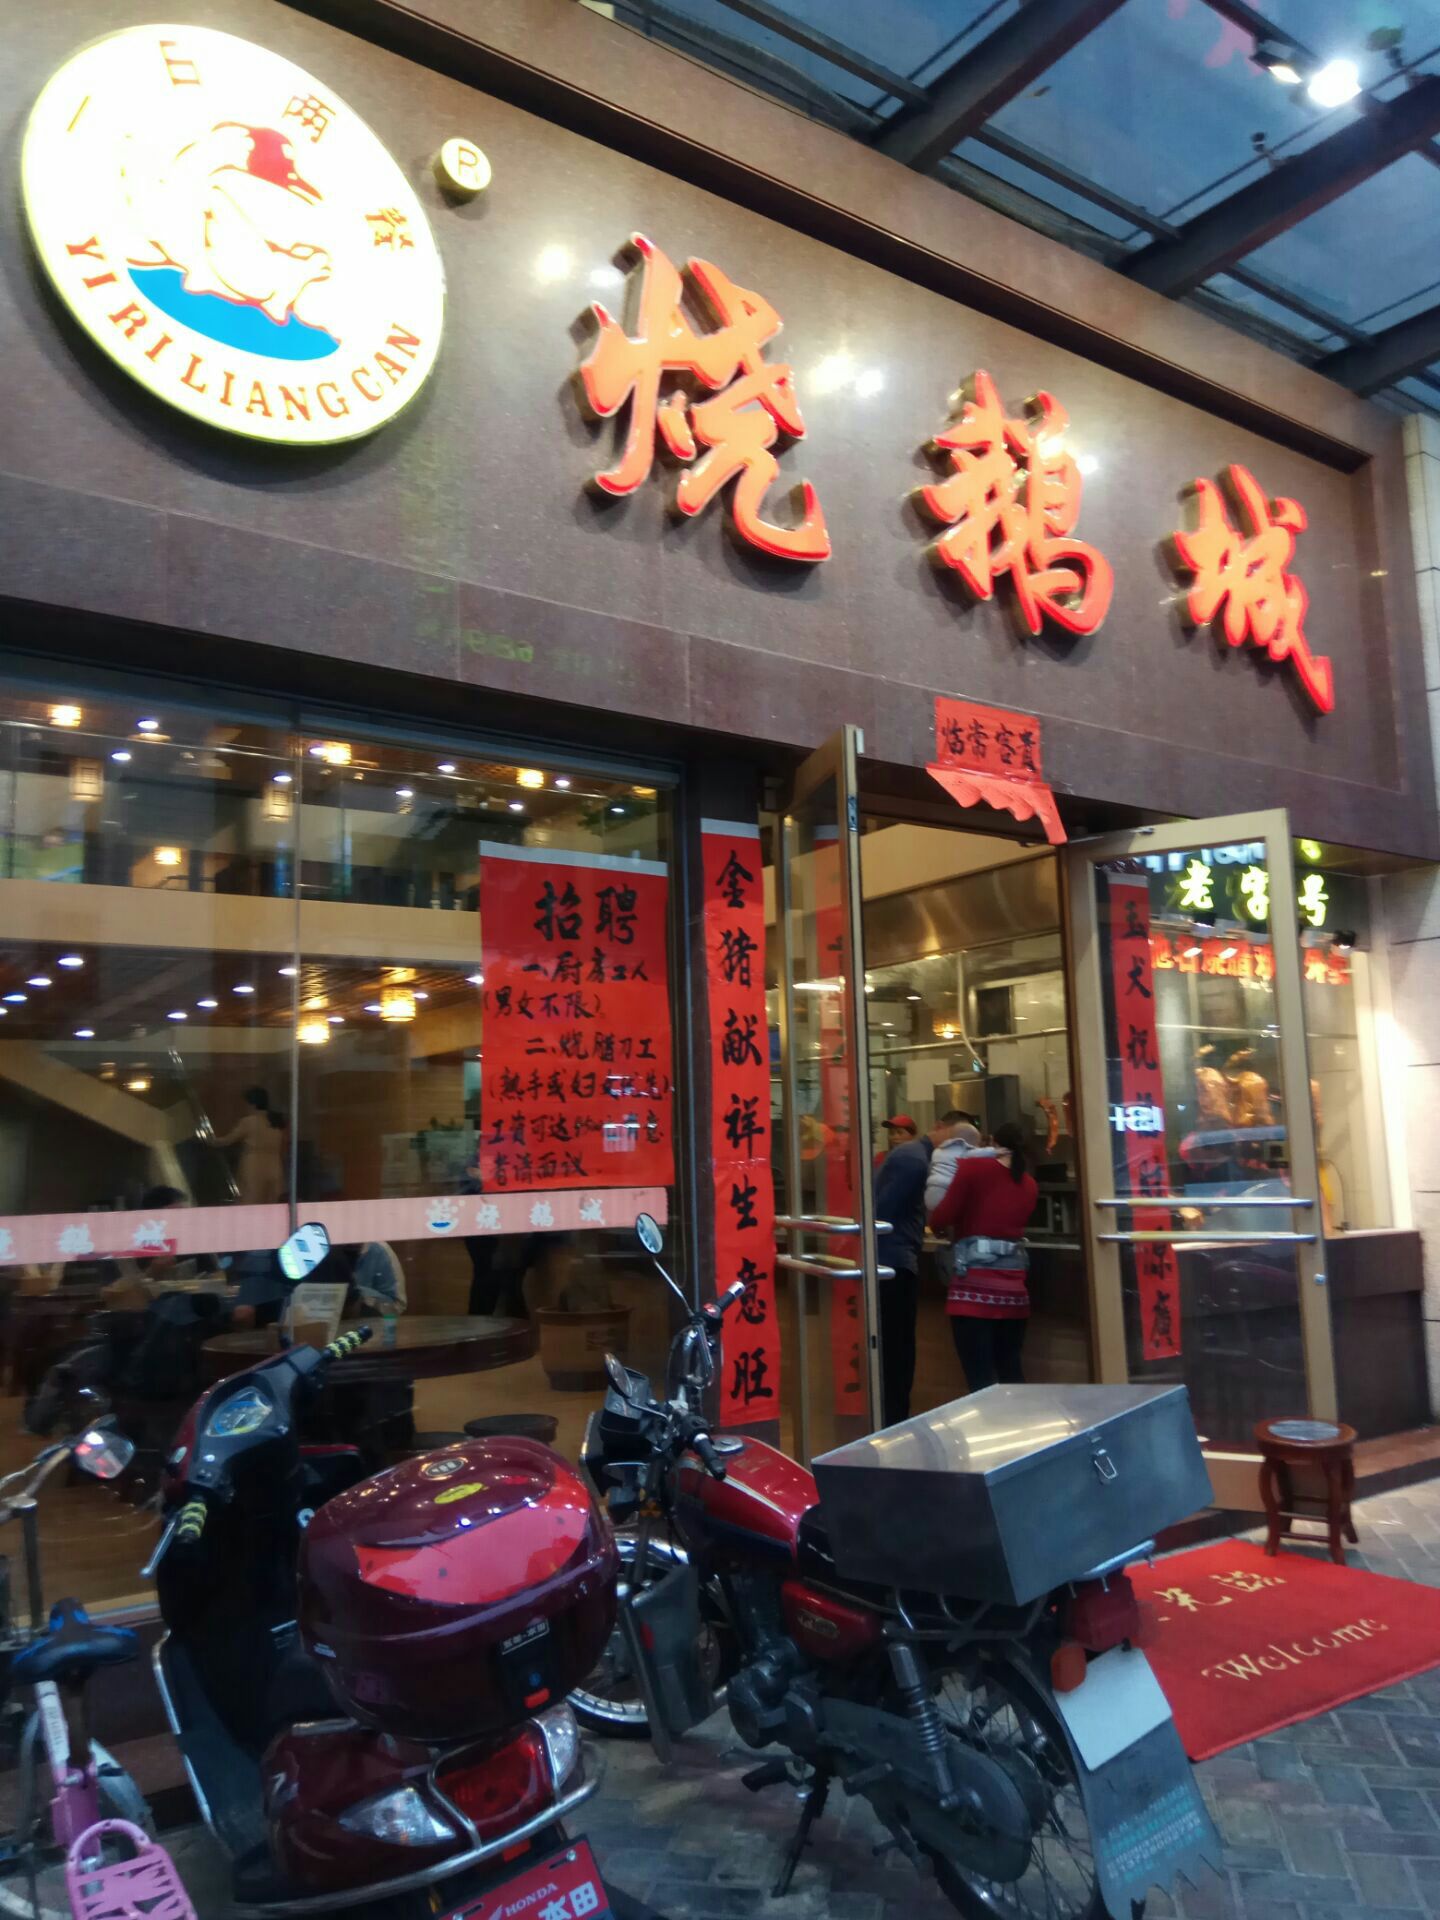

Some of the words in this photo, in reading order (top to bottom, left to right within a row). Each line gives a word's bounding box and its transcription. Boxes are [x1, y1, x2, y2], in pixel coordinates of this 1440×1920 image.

[534, 882, 640, 945] 招聘
[714, 850, 776, 1405] 金猪献祥生意旺
[1202, 1617, 1389, 1681] Welcome
[504, 1882, 559, 1917] HONDA
